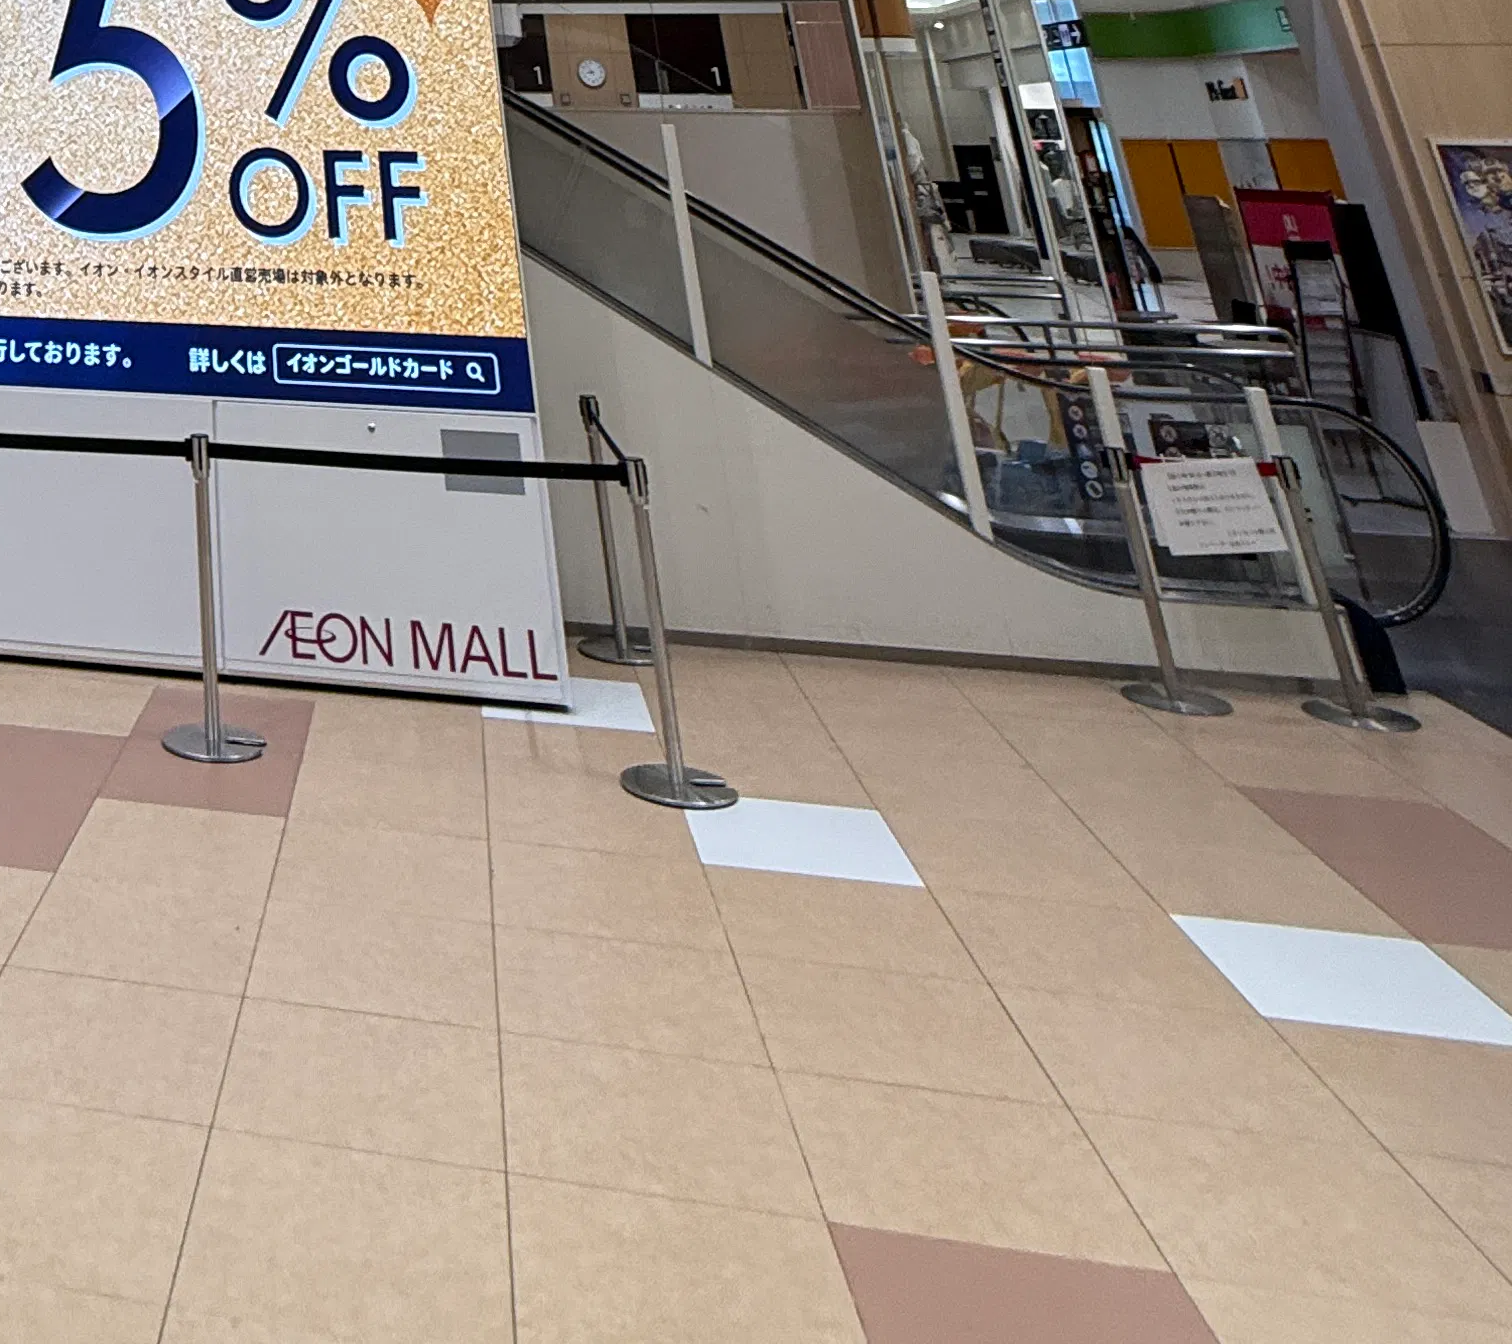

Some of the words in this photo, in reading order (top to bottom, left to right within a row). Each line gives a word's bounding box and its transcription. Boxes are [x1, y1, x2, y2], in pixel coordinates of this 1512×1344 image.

[228, 147, 430, 247] OFF
[188, 346, 267, 376] 詳しくは
[286, 350, 454, 381] イオンゴールドカード
[410, 619, 559, 682] MALL
